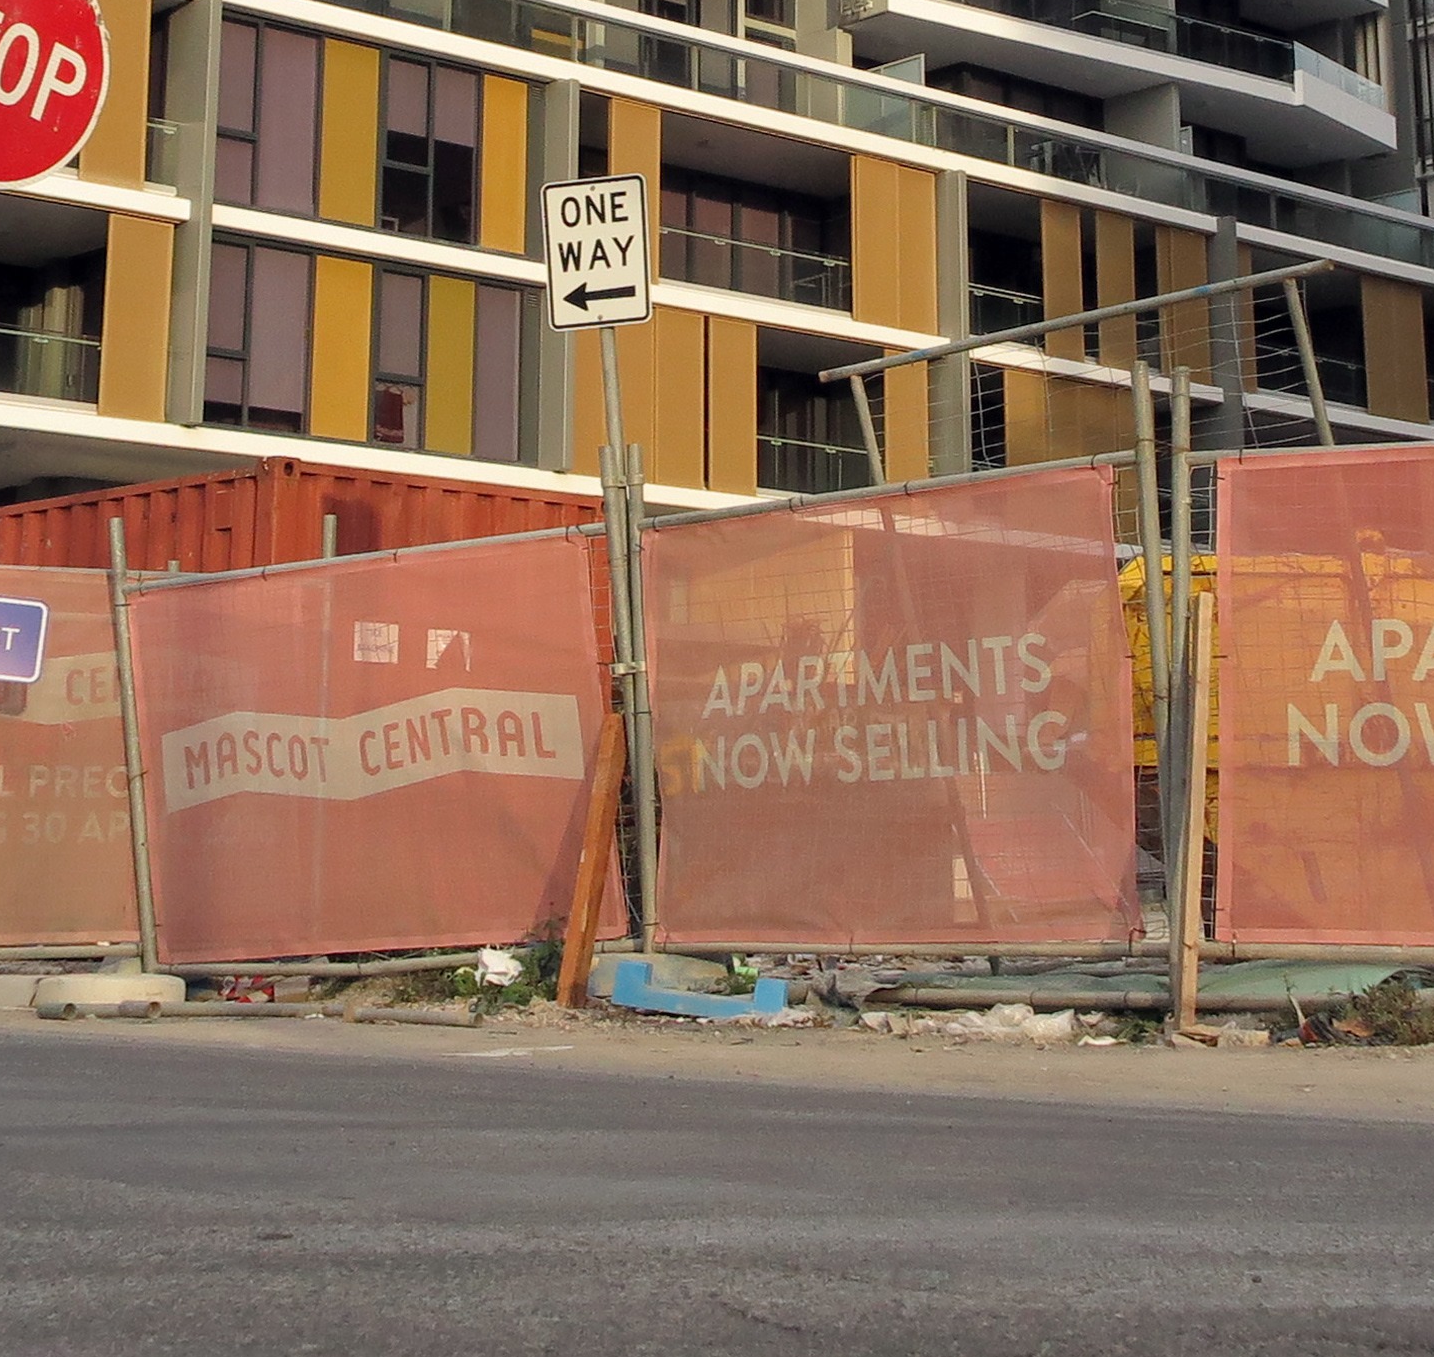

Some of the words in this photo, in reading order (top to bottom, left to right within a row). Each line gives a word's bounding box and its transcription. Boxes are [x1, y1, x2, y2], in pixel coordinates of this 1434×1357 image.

[561, 191, 629, 228] ONE
[557, 235, 635, 273] WAY
[701, 632, 1053, 720] APARTMENTS
[184, 729, 329, 790] MASCOT
[358, 706, 558, 777] CENTRAL
[695, 728, 817, 792] NOW
[833, 711, 1069, 784] SELLING
[28, 764, 129, 798] PREC
